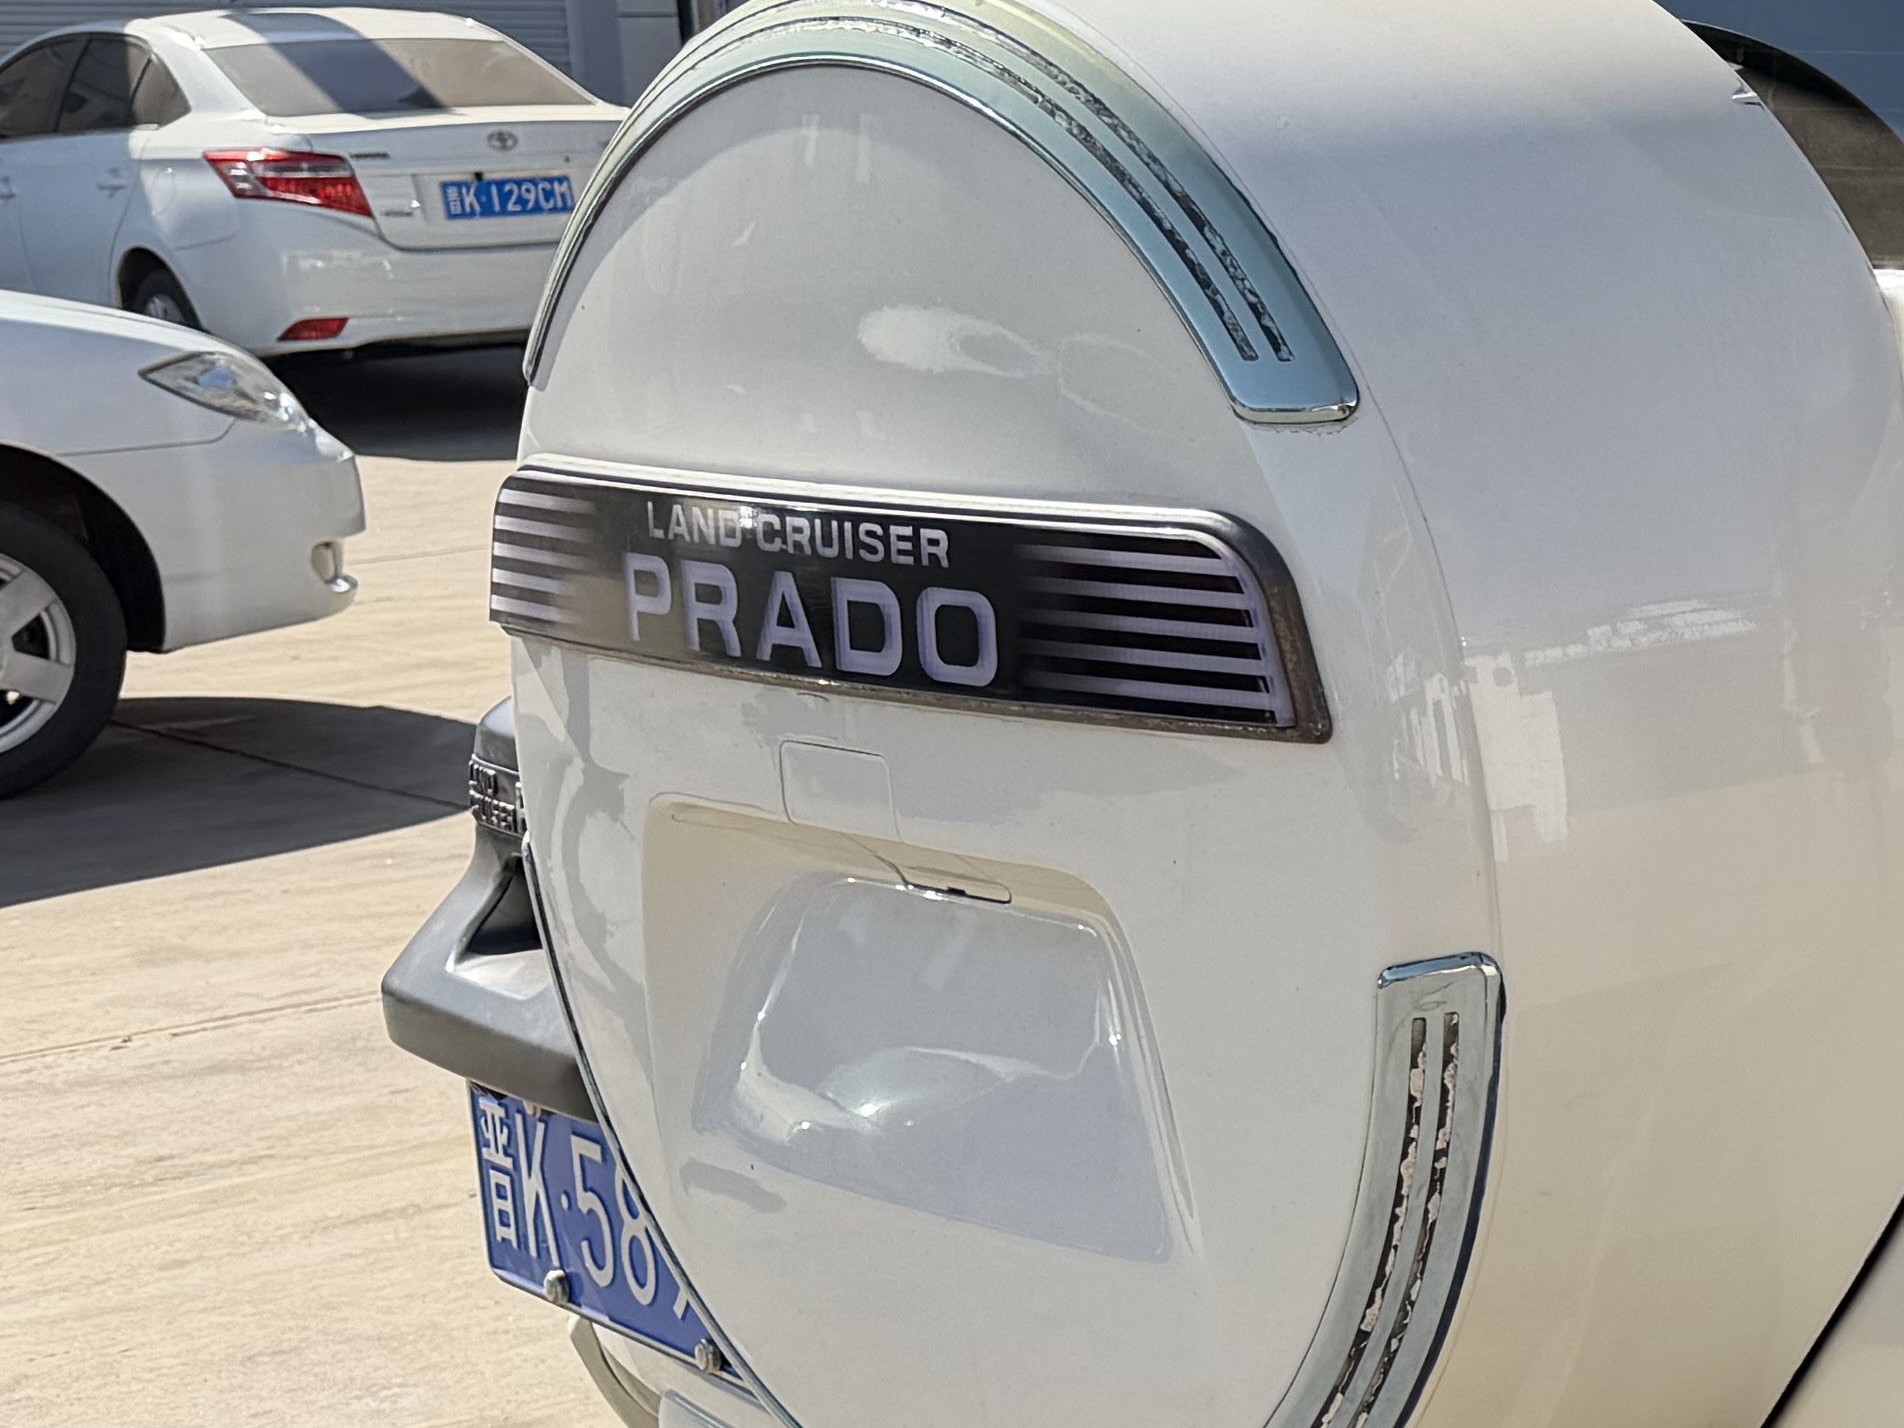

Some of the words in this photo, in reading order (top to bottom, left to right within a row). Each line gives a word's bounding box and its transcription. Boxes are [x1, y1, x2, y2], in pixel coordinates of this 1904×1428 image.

[647, 501, 743, 549] LAND
[755, 511, 951, 568] CRUISER
[624, 552, 1000, 687] PRADO
